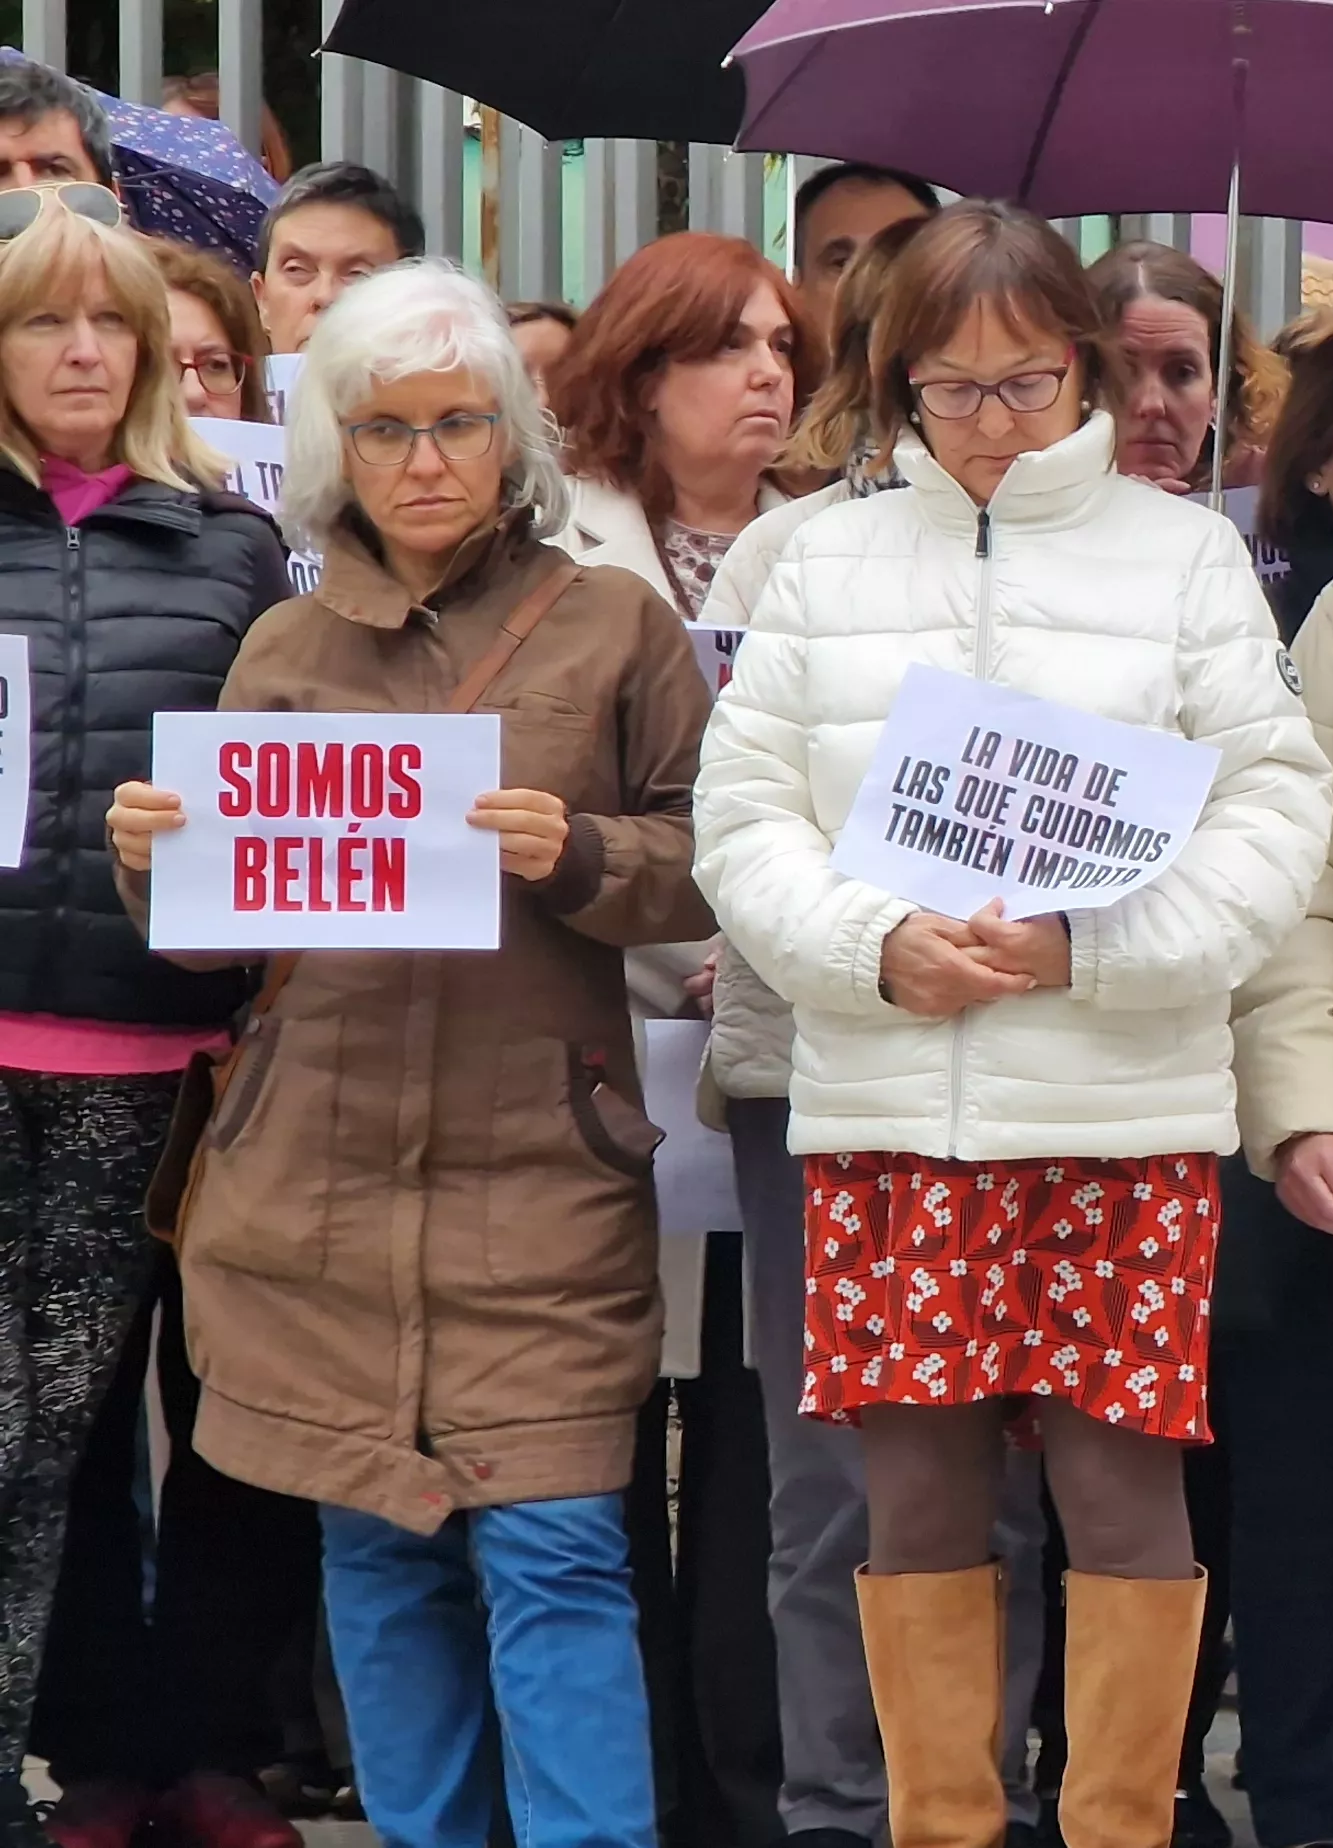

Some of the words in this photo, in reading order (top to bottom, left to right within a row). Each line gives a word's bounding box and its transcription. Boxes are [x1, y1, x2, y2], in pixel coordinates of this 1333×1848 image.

[218, 742, 422, 819] SOMOS
[961, 726, 1002, 769] LA
[1007, 738, 1079, 793] VIDA
[1083, 762, 1128, 807] DE
[884, 803, 1015, 878] TAMBIÉN
[892, 756, 951, 805] LAS
[954, 774, 1017, 826] QUE
[1020, 794, 1172, 863] CUIDAMOS
[233, 823, 406, 912] BELÉN
